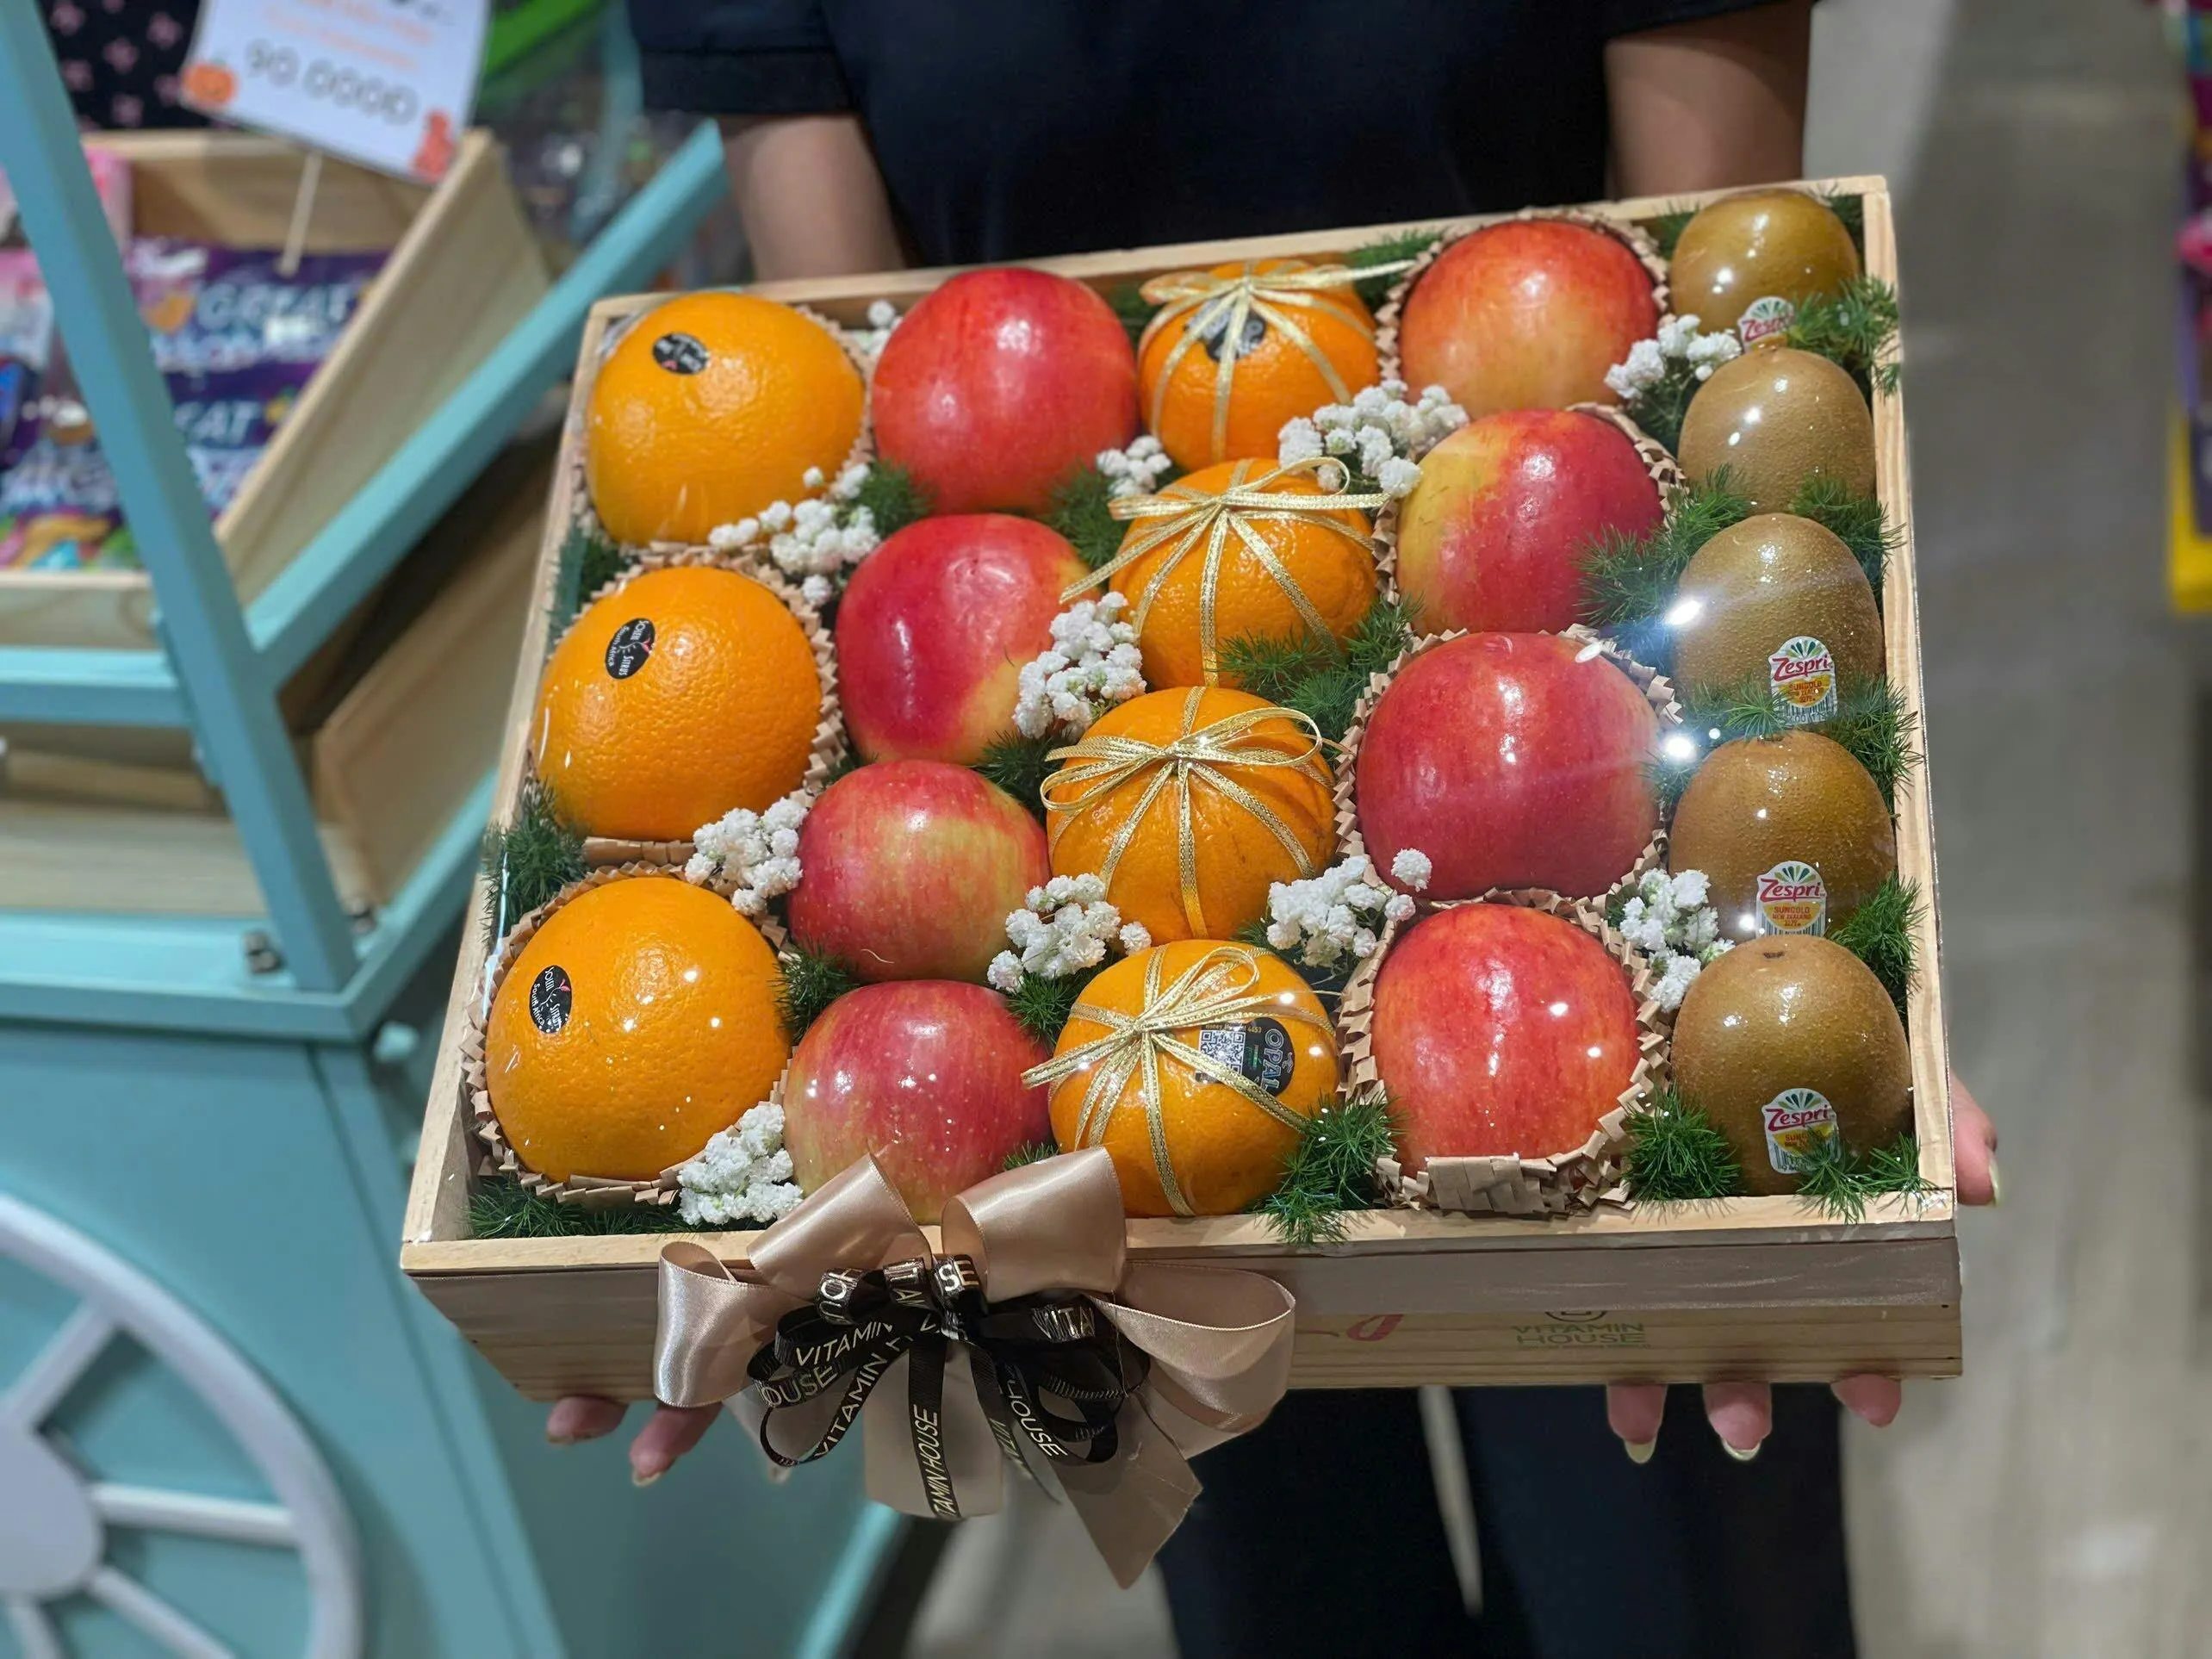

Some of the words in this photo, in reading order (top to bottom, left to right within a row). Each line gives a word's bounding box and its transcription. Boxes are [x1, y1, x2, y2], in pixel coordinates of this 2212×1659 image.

[1772, 655, 1830, 681] Zespri
[1760, 878, 1821, 903] Zespri
[531, 983, 540, 1007] South
[532, 1006, 545, 1026] Africa
[1260, 1028, 1285, 1090] OPAL
[1766, 1104, 1830, 1132] Zespri
[1511, 1323, 1644, 1334] VITAMIN
[1516, 1333, 1645, 1345] HOUSE
[761, 1365, 839, 1407] OUSE
[814, 1353, 888, 1457] VITAMIN
[1007, 1379, 1068, 1457] HOUSE
[913, 1403, 946, 1474] HOUSE
[925, 1469, 959, 1518] TAMIN
